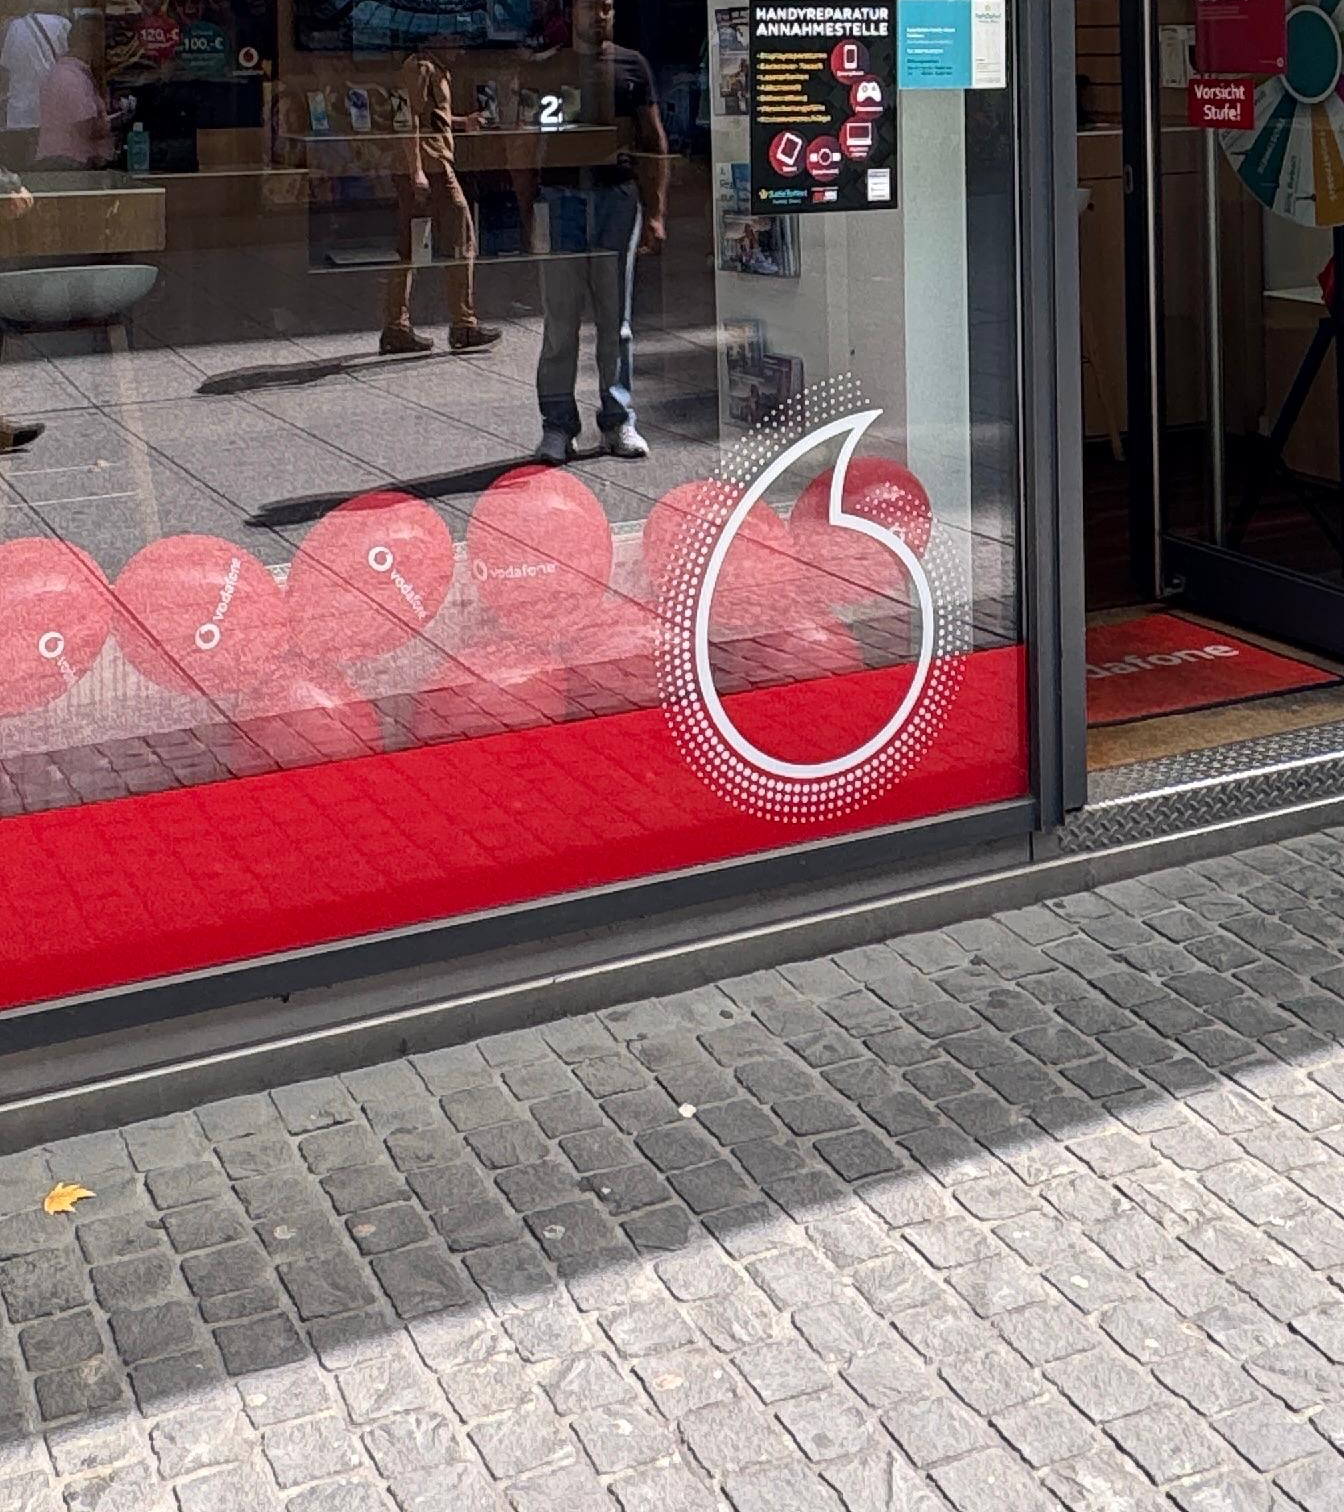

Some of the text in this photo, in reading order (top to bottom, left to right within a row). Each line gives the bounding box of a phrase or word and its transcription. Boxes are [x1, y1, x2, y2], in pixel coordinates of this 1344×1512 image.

[756, 7, 888, 21] HANDYREPARATUR
[756, 22, 888, 37] ANNAHMESTELLE
[1194, 82, 1246, 100] Vorsicht
[1202, 102, 1242, 122] Stufe!
[489, 561, 557, 579] vodafone
[213, 557, 242, 620] vodafone
